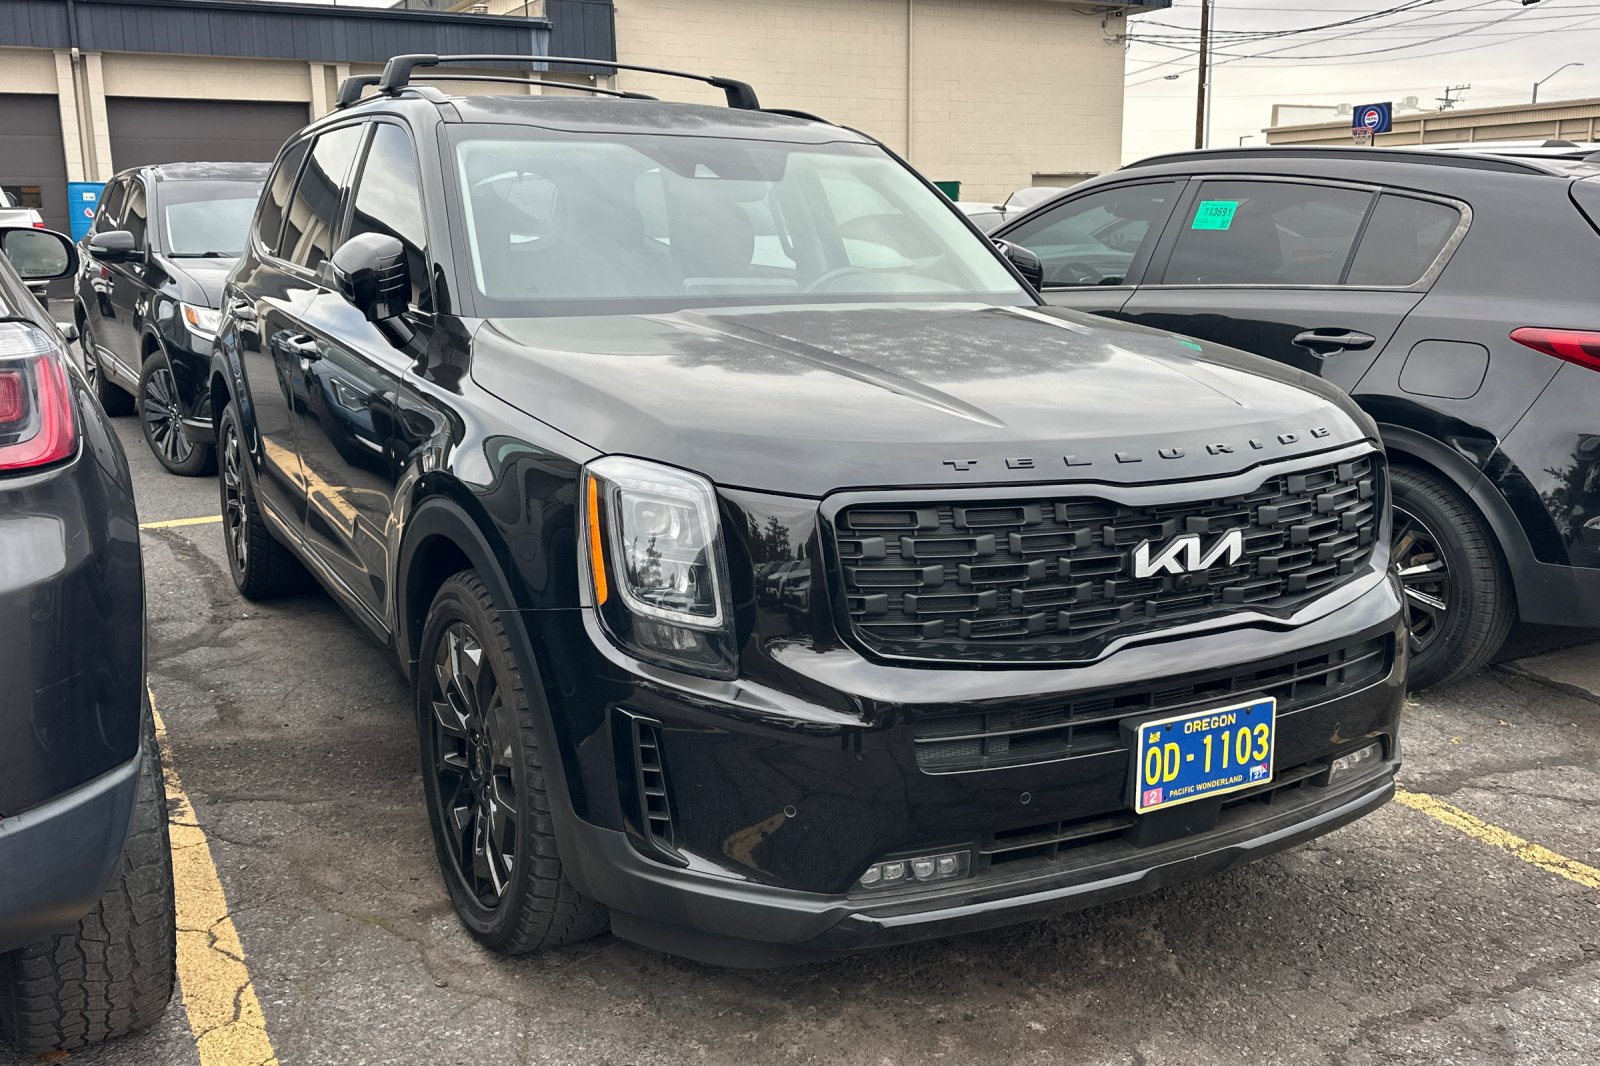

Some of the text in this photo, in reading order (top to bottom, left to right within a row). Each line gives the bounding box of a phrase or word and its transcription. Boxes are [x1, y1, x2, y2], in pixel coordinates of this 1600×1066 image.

[1204, 207, 1233, 217] 113691
[942, 426, 1331, 471] TELLURIDE
[1132, 527, 1242, 579] KIA
[1184, 713, 1237, 734] OREGON
[1169, 774, 1243, 797] PACIFIC WONDERLAND
[1149, 790, 1157, 805] 2
